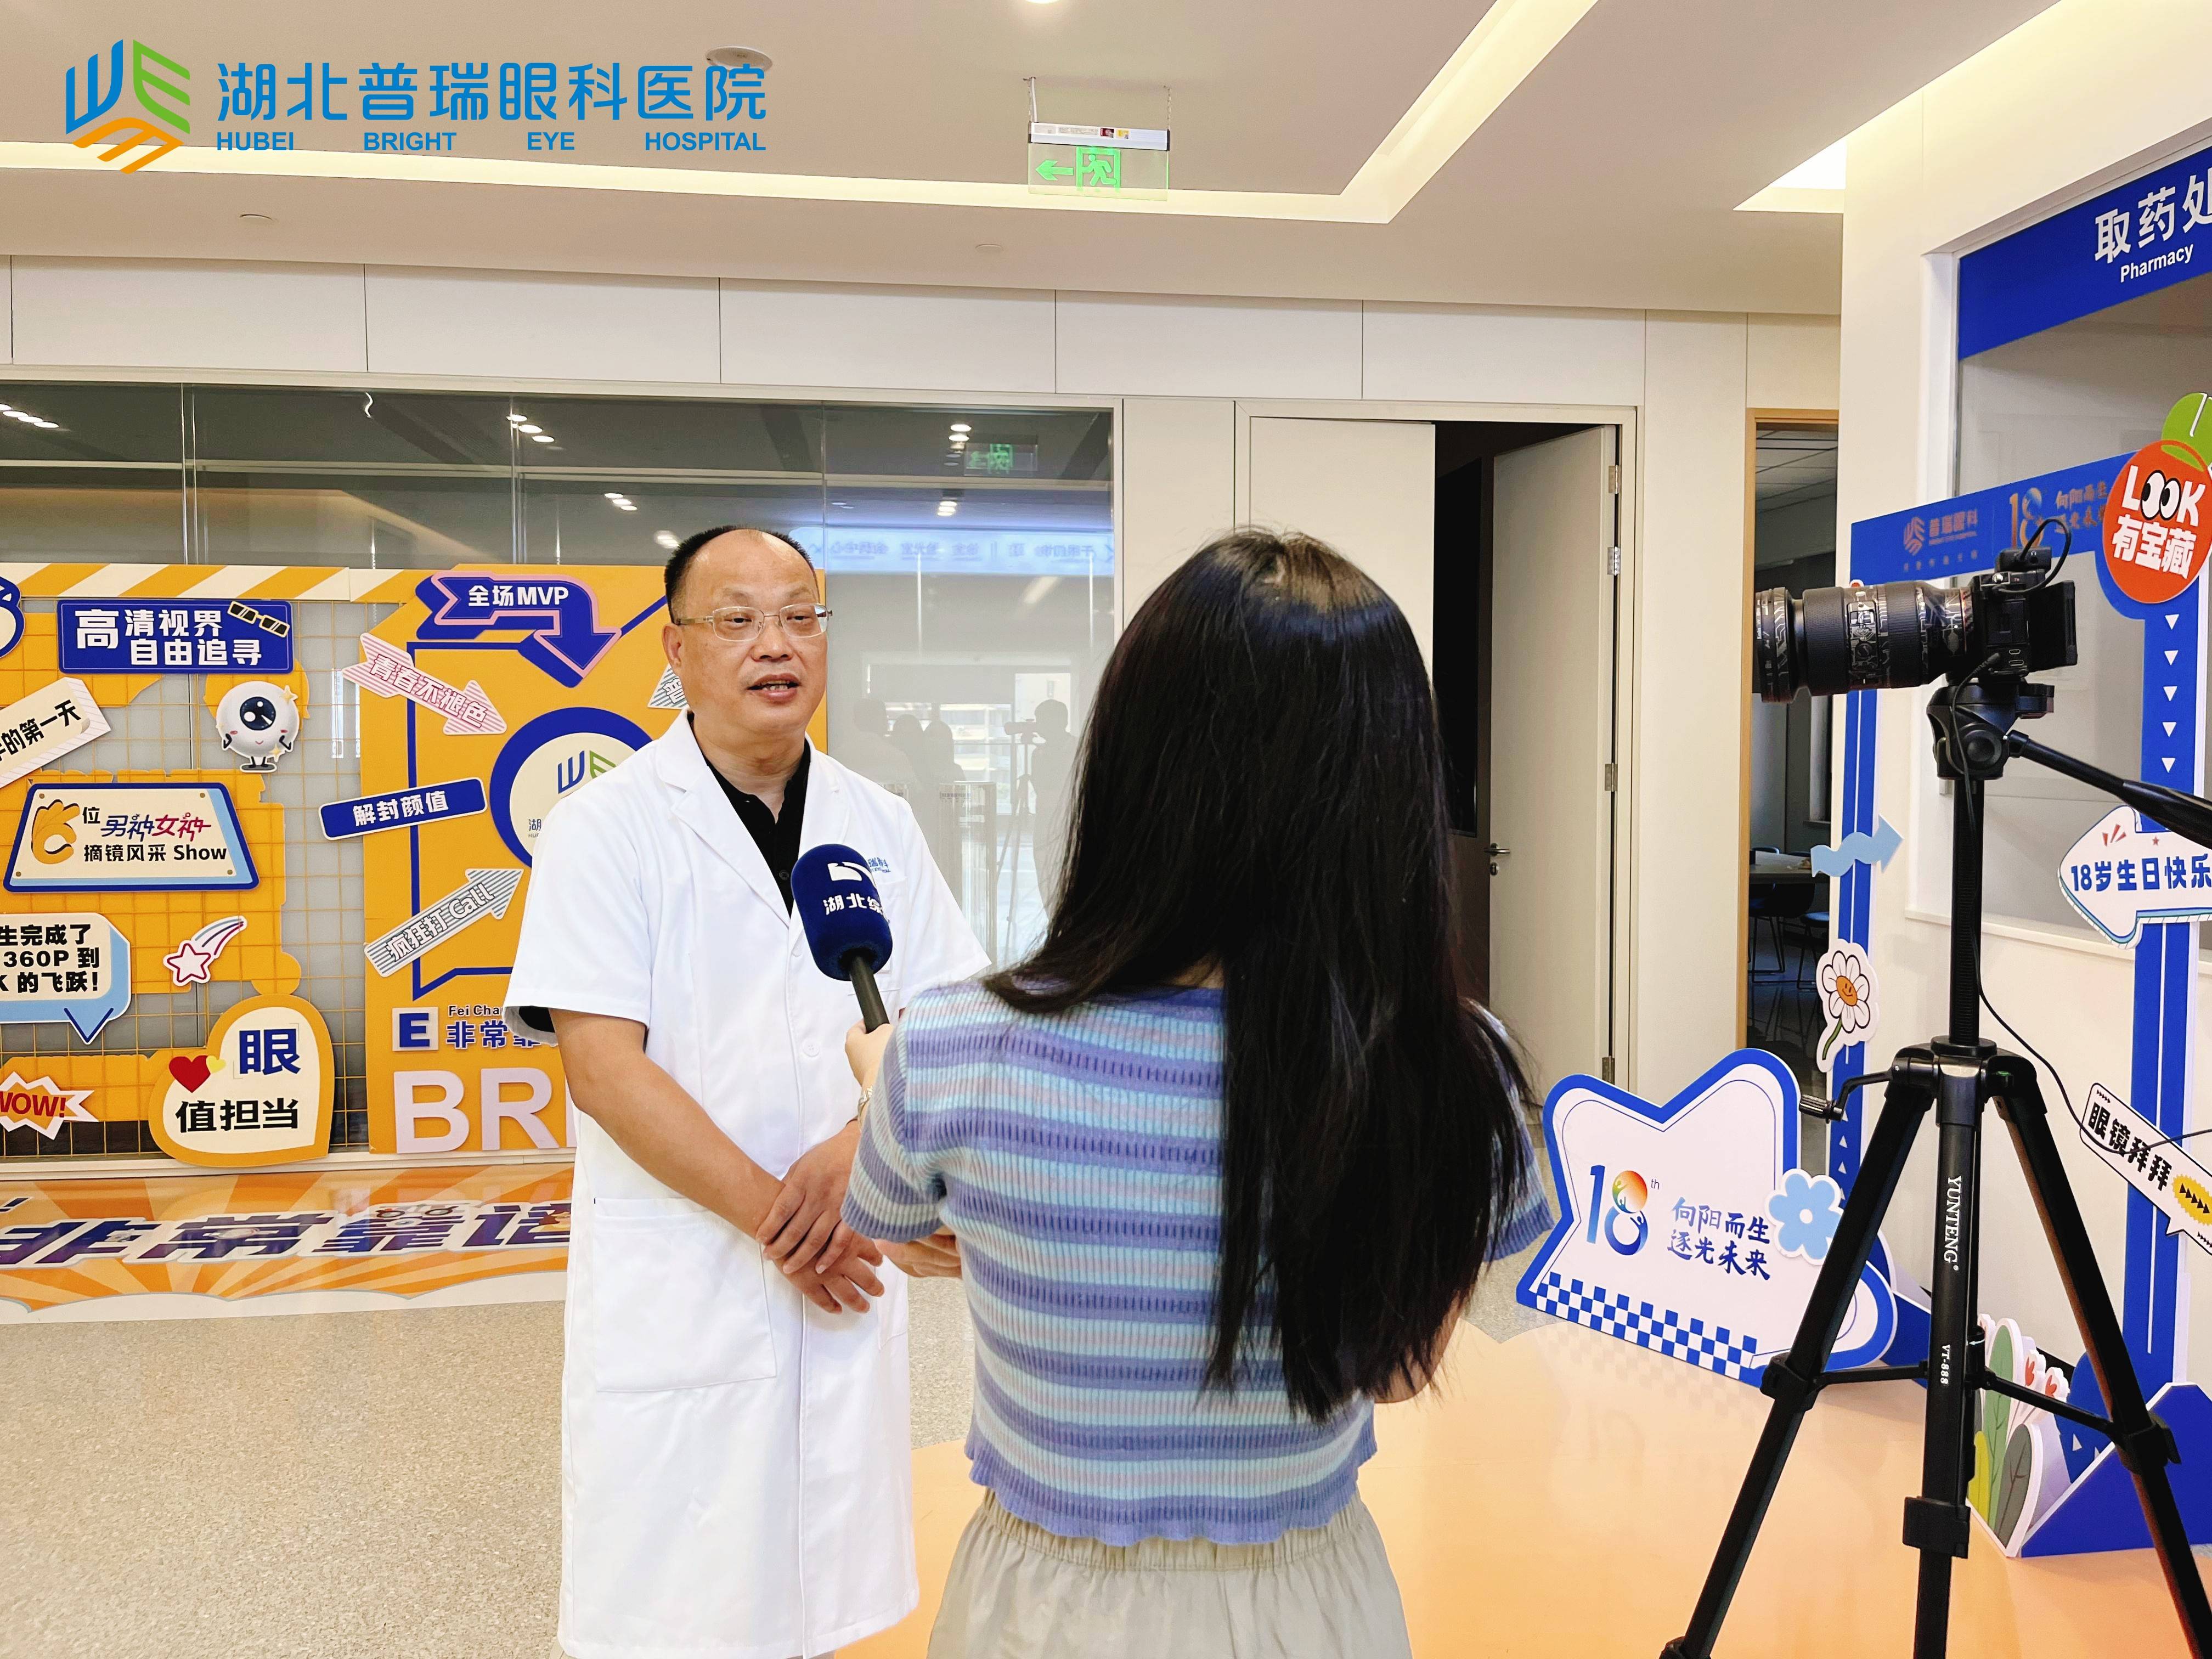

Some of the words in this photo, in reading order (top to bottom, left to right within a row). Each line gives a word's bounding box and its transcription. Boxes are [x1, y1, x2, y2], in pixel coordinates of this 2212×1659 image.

[2094, 167, 2212, 264] 取药处
[2120, 244, 2194, 283] Pharmacy
[2121, 464, 2207, 528] LOOK
[2112, 514, 2198, 579] 有宝藏
[468, 585, 569, 607] 全场MVP
[75, 609, 222, 650] 高清视界
[130, 639, 262, 666] 自由追寻
[370, 652, 488, 730] 青春不褪色
[82, 807, 100, 824] 位
[352, 790, 449, 826] 解封颜值
[528, 818, 542, 832] 湖
[83, 845, 166, 862] 摘镜风采
[174, 845, 227, 860] Show
[2071, 854, 2212, 891] 18岁生日快乐
[0, 924, 91, 946] 生完成了
[386, 909, 449, 961] 疯狂打
[448, 883, 494, 919] Call
[3, 950, 69, 968] 360P
[77, 947, 100, 968] 到
[17, 970, 98, 994] 的飞跃!
[448, 1005, 470, 1016] Fei
[473, 1005, 502, 1015] Cha
[399, 1013, 430, 1047] E
[239, 1028, 301, 1075] 眼
[175, 1098, 299, 1133] 值担当
[2088, 1102, 2172, 1191] 眼镜拜拜
[1672, 1197, 1771, 1244] 向阳而生
[1667, 1228, 1771, 1280] 逐光未来
[1940, 1344, 1950, 1384] VT-888
